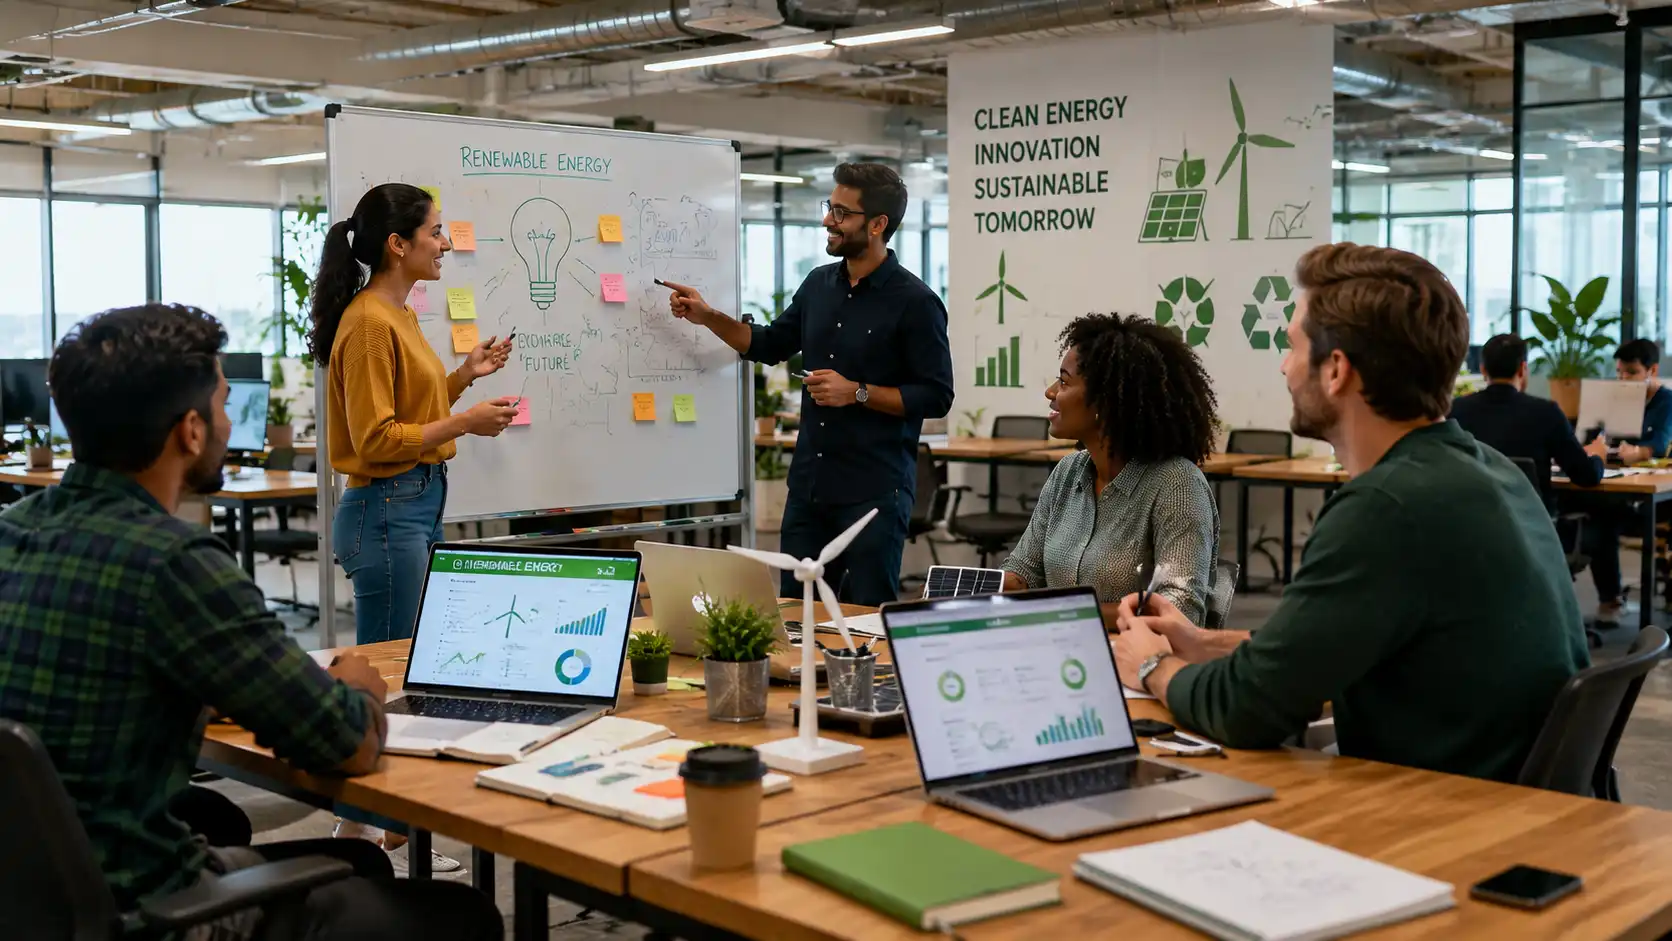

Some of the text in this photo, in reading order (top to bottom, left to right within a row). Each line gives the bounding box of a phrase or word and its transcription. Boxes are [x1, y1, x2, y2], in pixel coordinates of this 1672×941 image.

[974, 95, 1128, 131] CLEAN ENERGY
[459, 145, 612, 175] RENEWABLE ENERGY
[974, 134, 1100, 165] INNOVATION
[974, 170, 1109, 200] SUSTAINABLE
[973, 206, 1096, 234] TOMORROW
